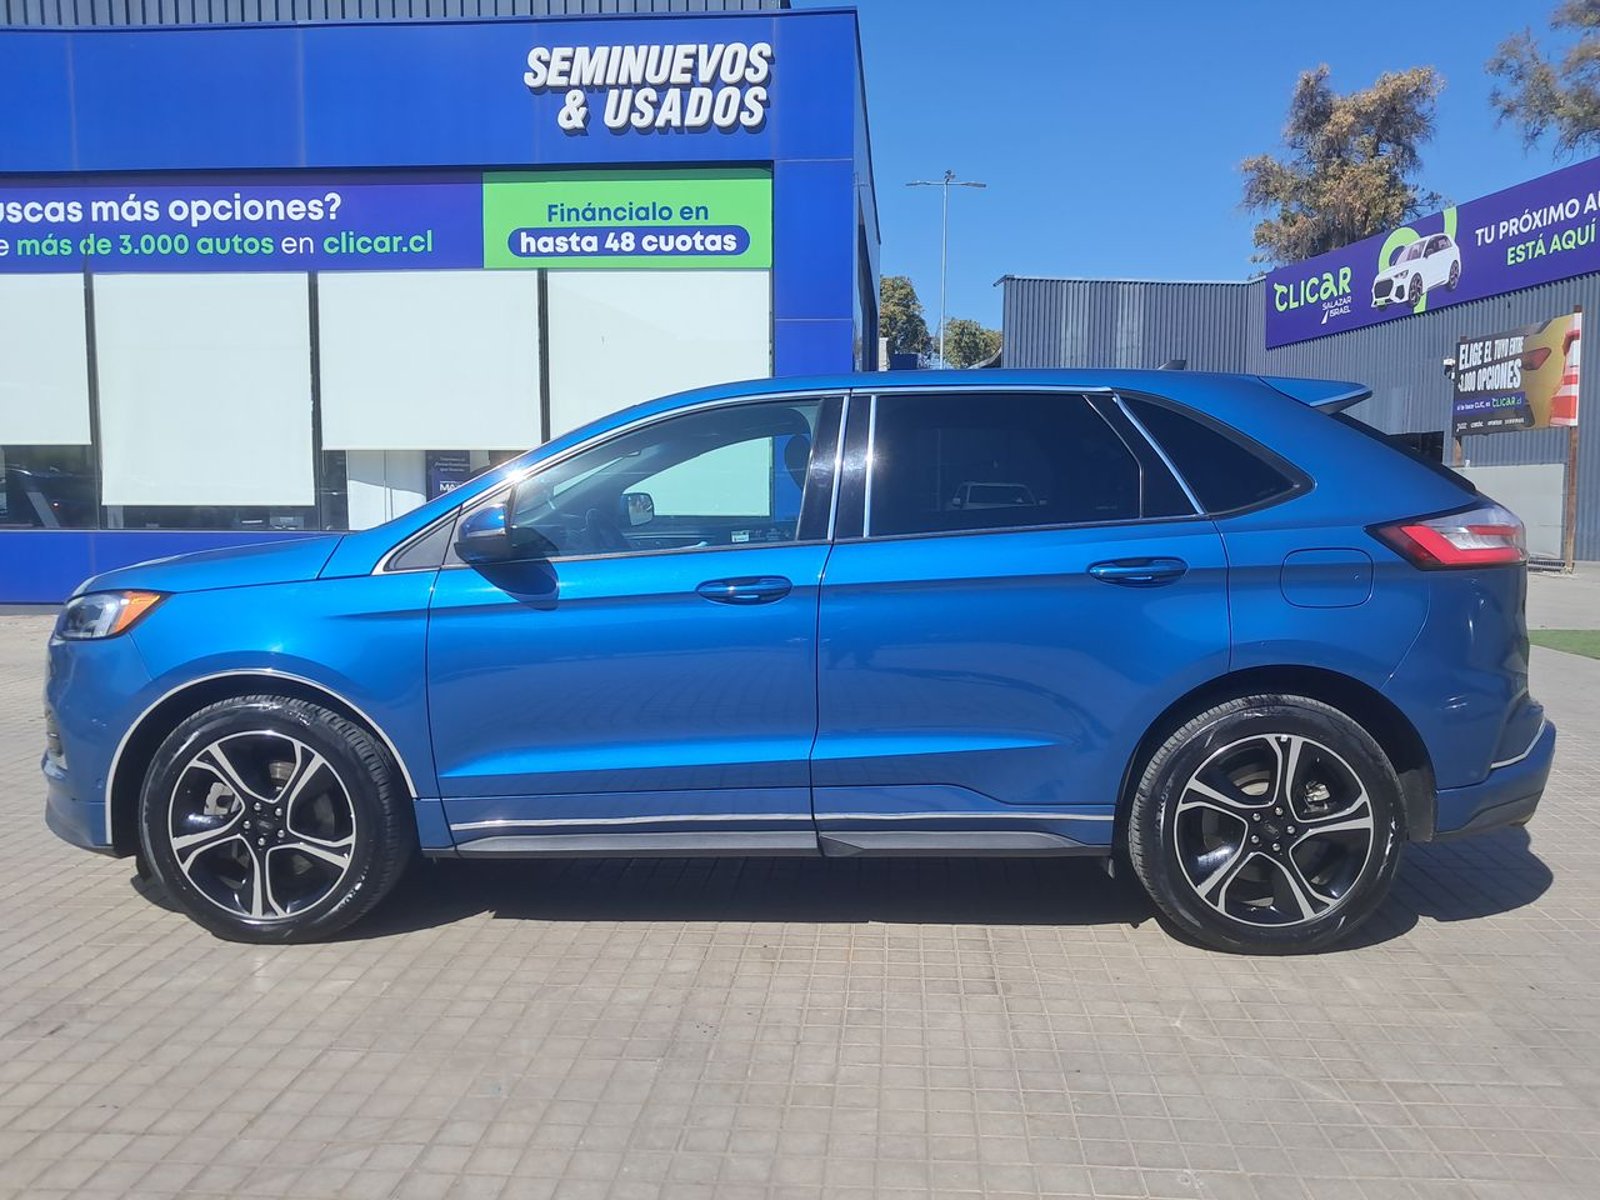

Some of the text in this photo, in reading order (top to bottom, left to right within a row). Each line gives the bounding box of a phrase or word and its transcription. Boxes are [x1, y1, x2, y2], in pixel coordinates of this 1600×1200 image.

[523, 42, 773, 89] SEMINUEVOS
[557, 86, 768, 131] & USADOS
[0, 192, 342, 228] scas más opciones?
[547, 202, 709, 223] Fináncialo en
[1475, 189, 1600, 246] TU PRÓXIMO A
[17, 233, 72, 256] más
[79, 233, 112, 255] de
[119, 234, 189, 255] 3.000
[196, 234, 275, 255] autos
[281, 236, 314, 254] en
[323, 229, 433, 253] clicar.cl
[520, 231, 738, 253] hasta 48 cuotas
[1507, 217, 1596, 266] ESTÁ AQUÍ
[1322, 295, 1352, 311] SALAZAR
[1459, 342, 1484, 370] ELIGE
[1484, 341, 1492, 363] EL
[1477, 358, 1522, 391] OPCIONES
